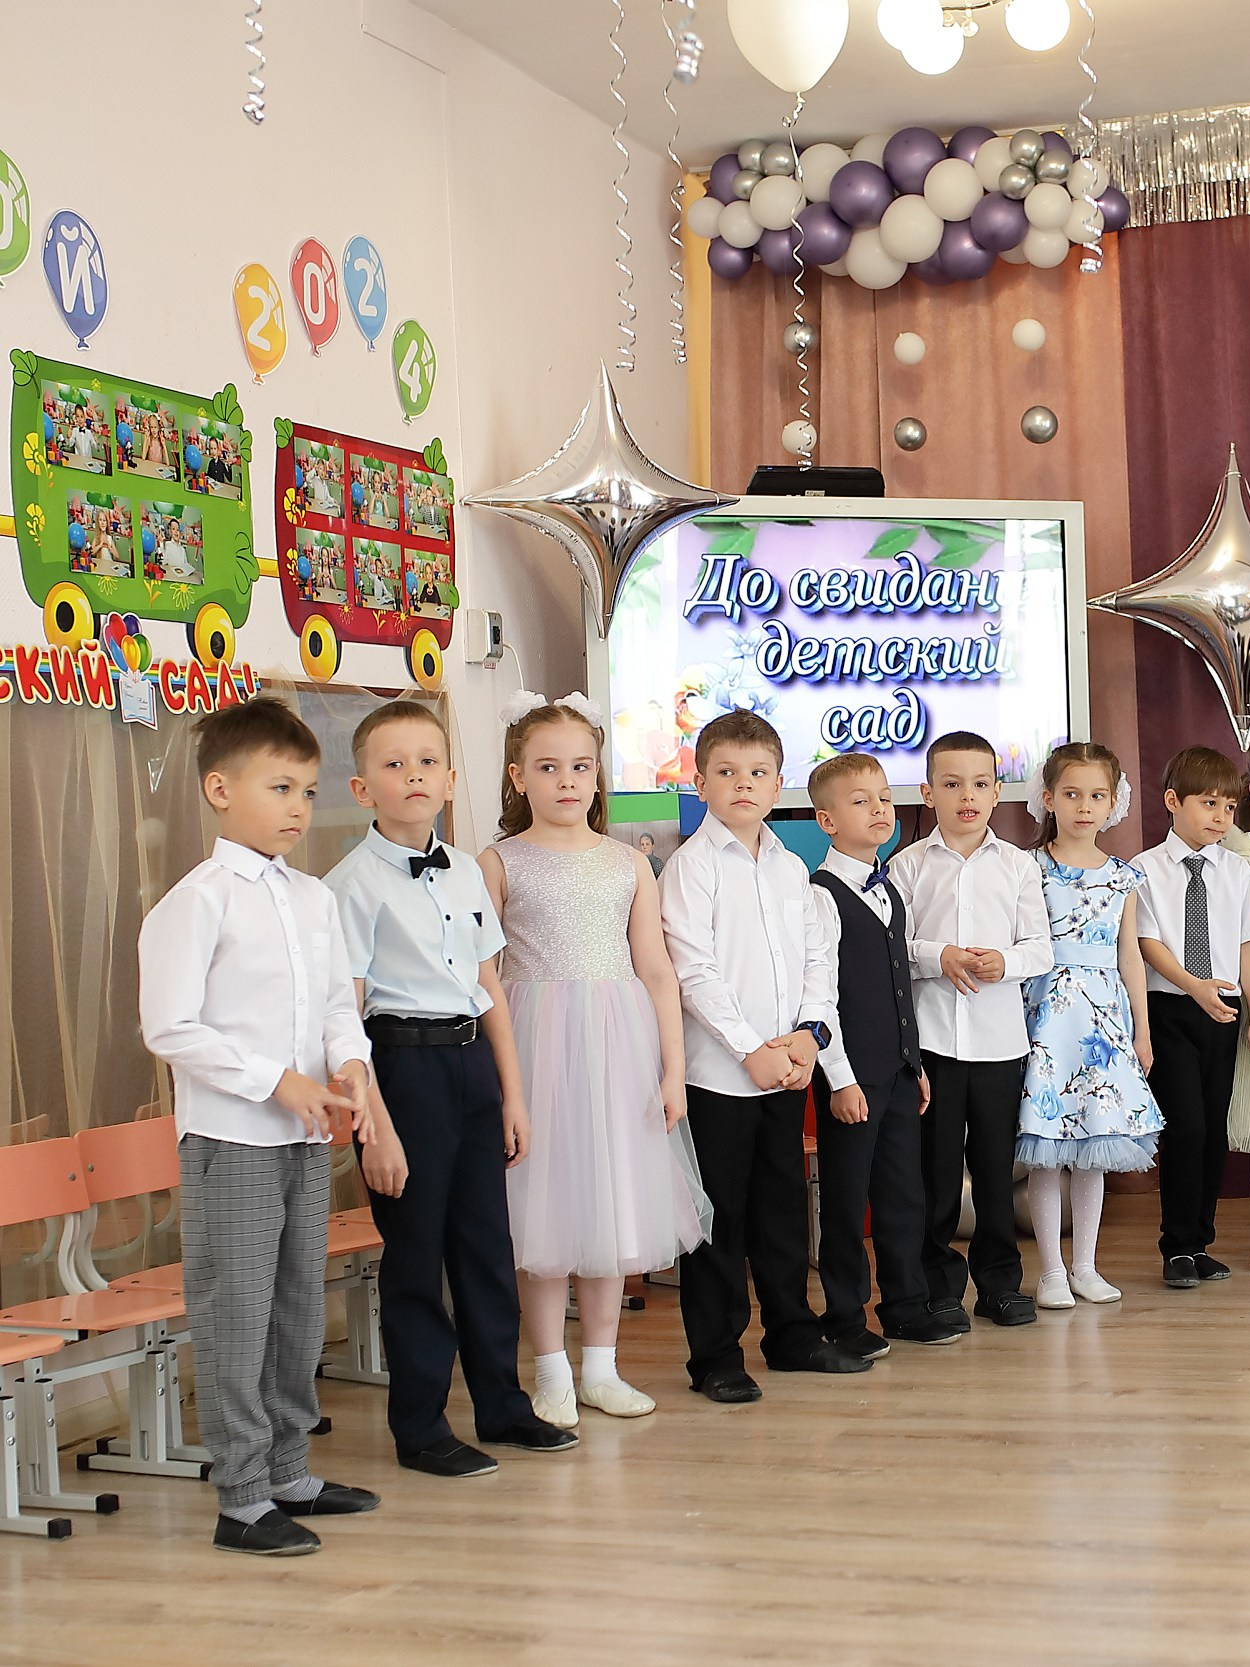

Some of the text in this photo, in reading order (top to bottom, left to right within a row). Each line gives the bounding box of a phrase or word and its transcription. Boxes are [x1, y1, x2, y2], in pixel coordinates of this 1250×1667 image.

[683, 554, 777, 622] До
[756, 619, 1012, 682] детский
[821, 687, 926, 750] сад
